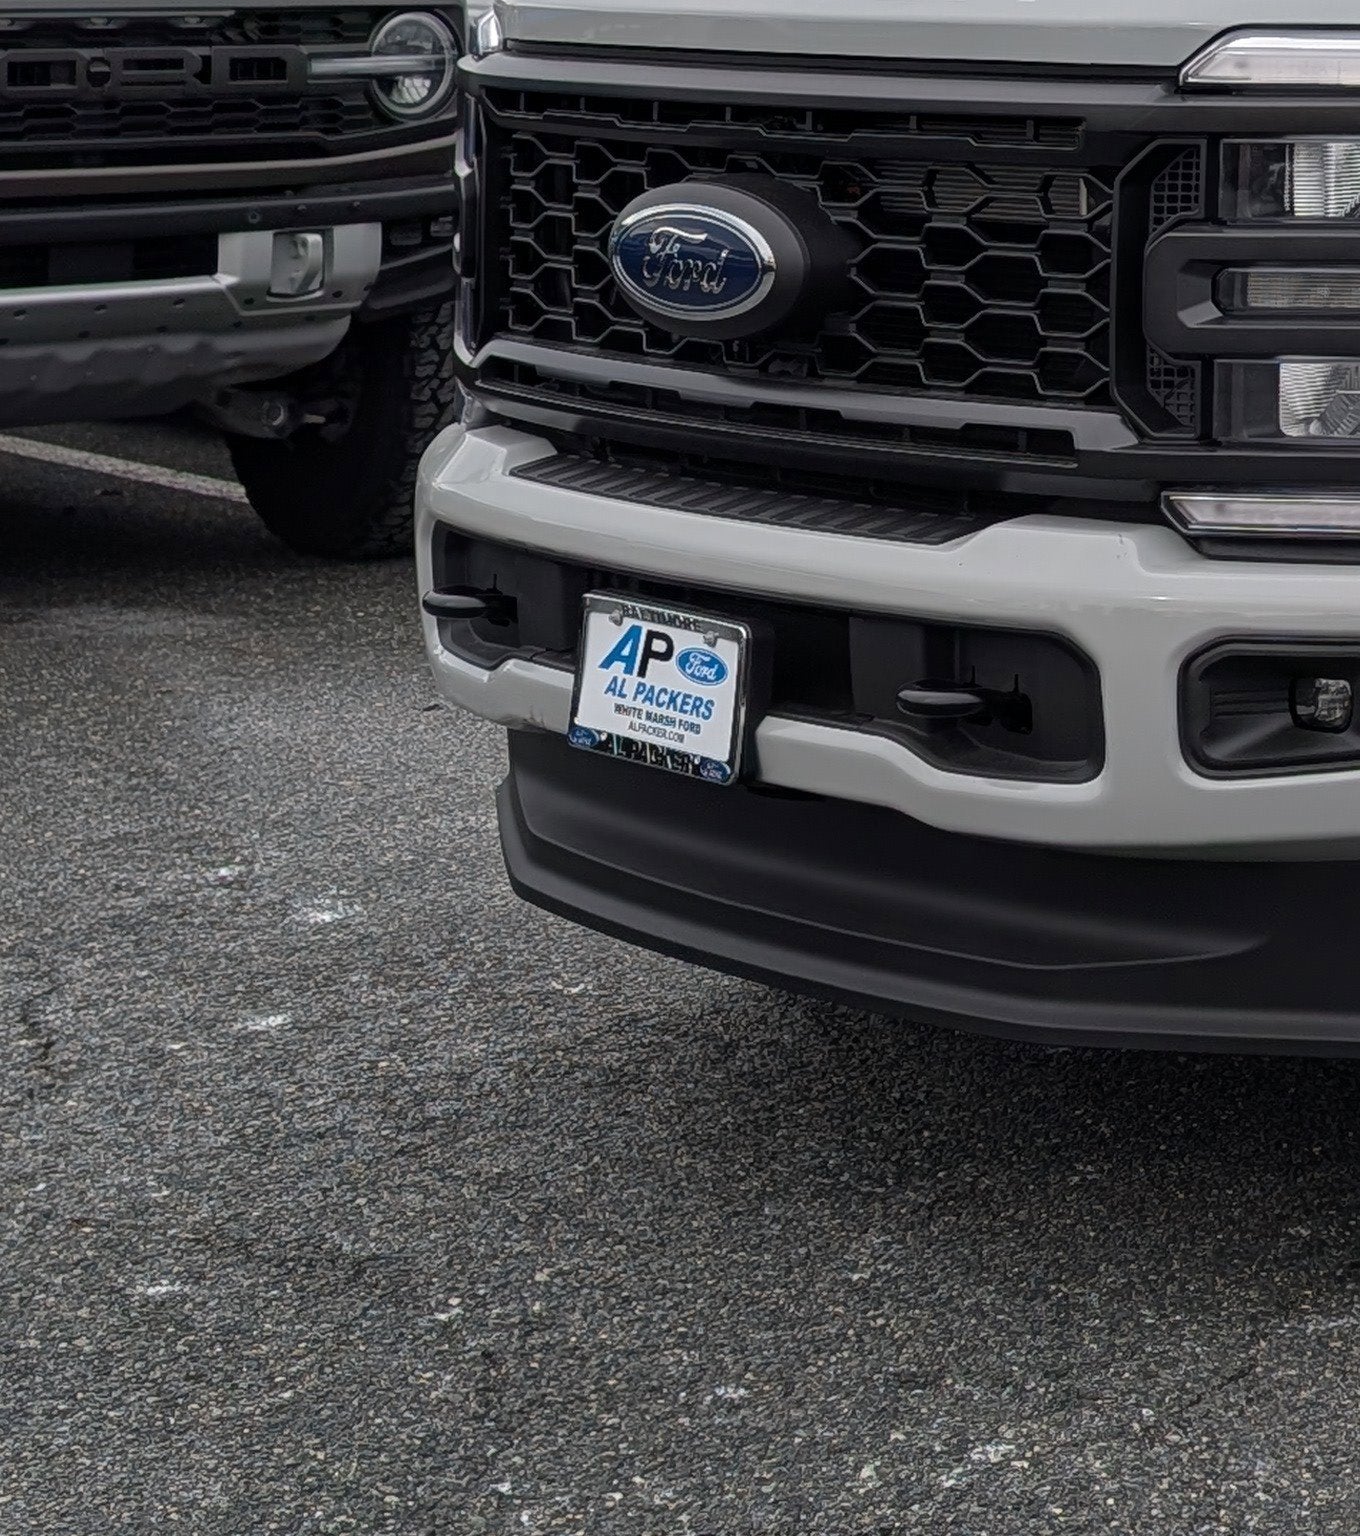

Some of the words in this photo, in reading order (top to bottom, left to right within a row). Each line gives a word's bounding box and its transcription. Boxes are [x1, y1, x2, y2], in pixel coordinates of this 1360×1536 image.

[641, 226, 730, 295] Ford
[598, 623, 675, 679] AP
[684, 651, 717, 681] Ford
[604, 675, 628, 699] AL
[632, 680, 716, 721] PACKERS
[613, 702, 643, 721] WHITE
[644, 710, 677, 727] MARSH
[677, 718, 702, 736] FORD
[627, 720, 686, 744] ALPACKER.COM
